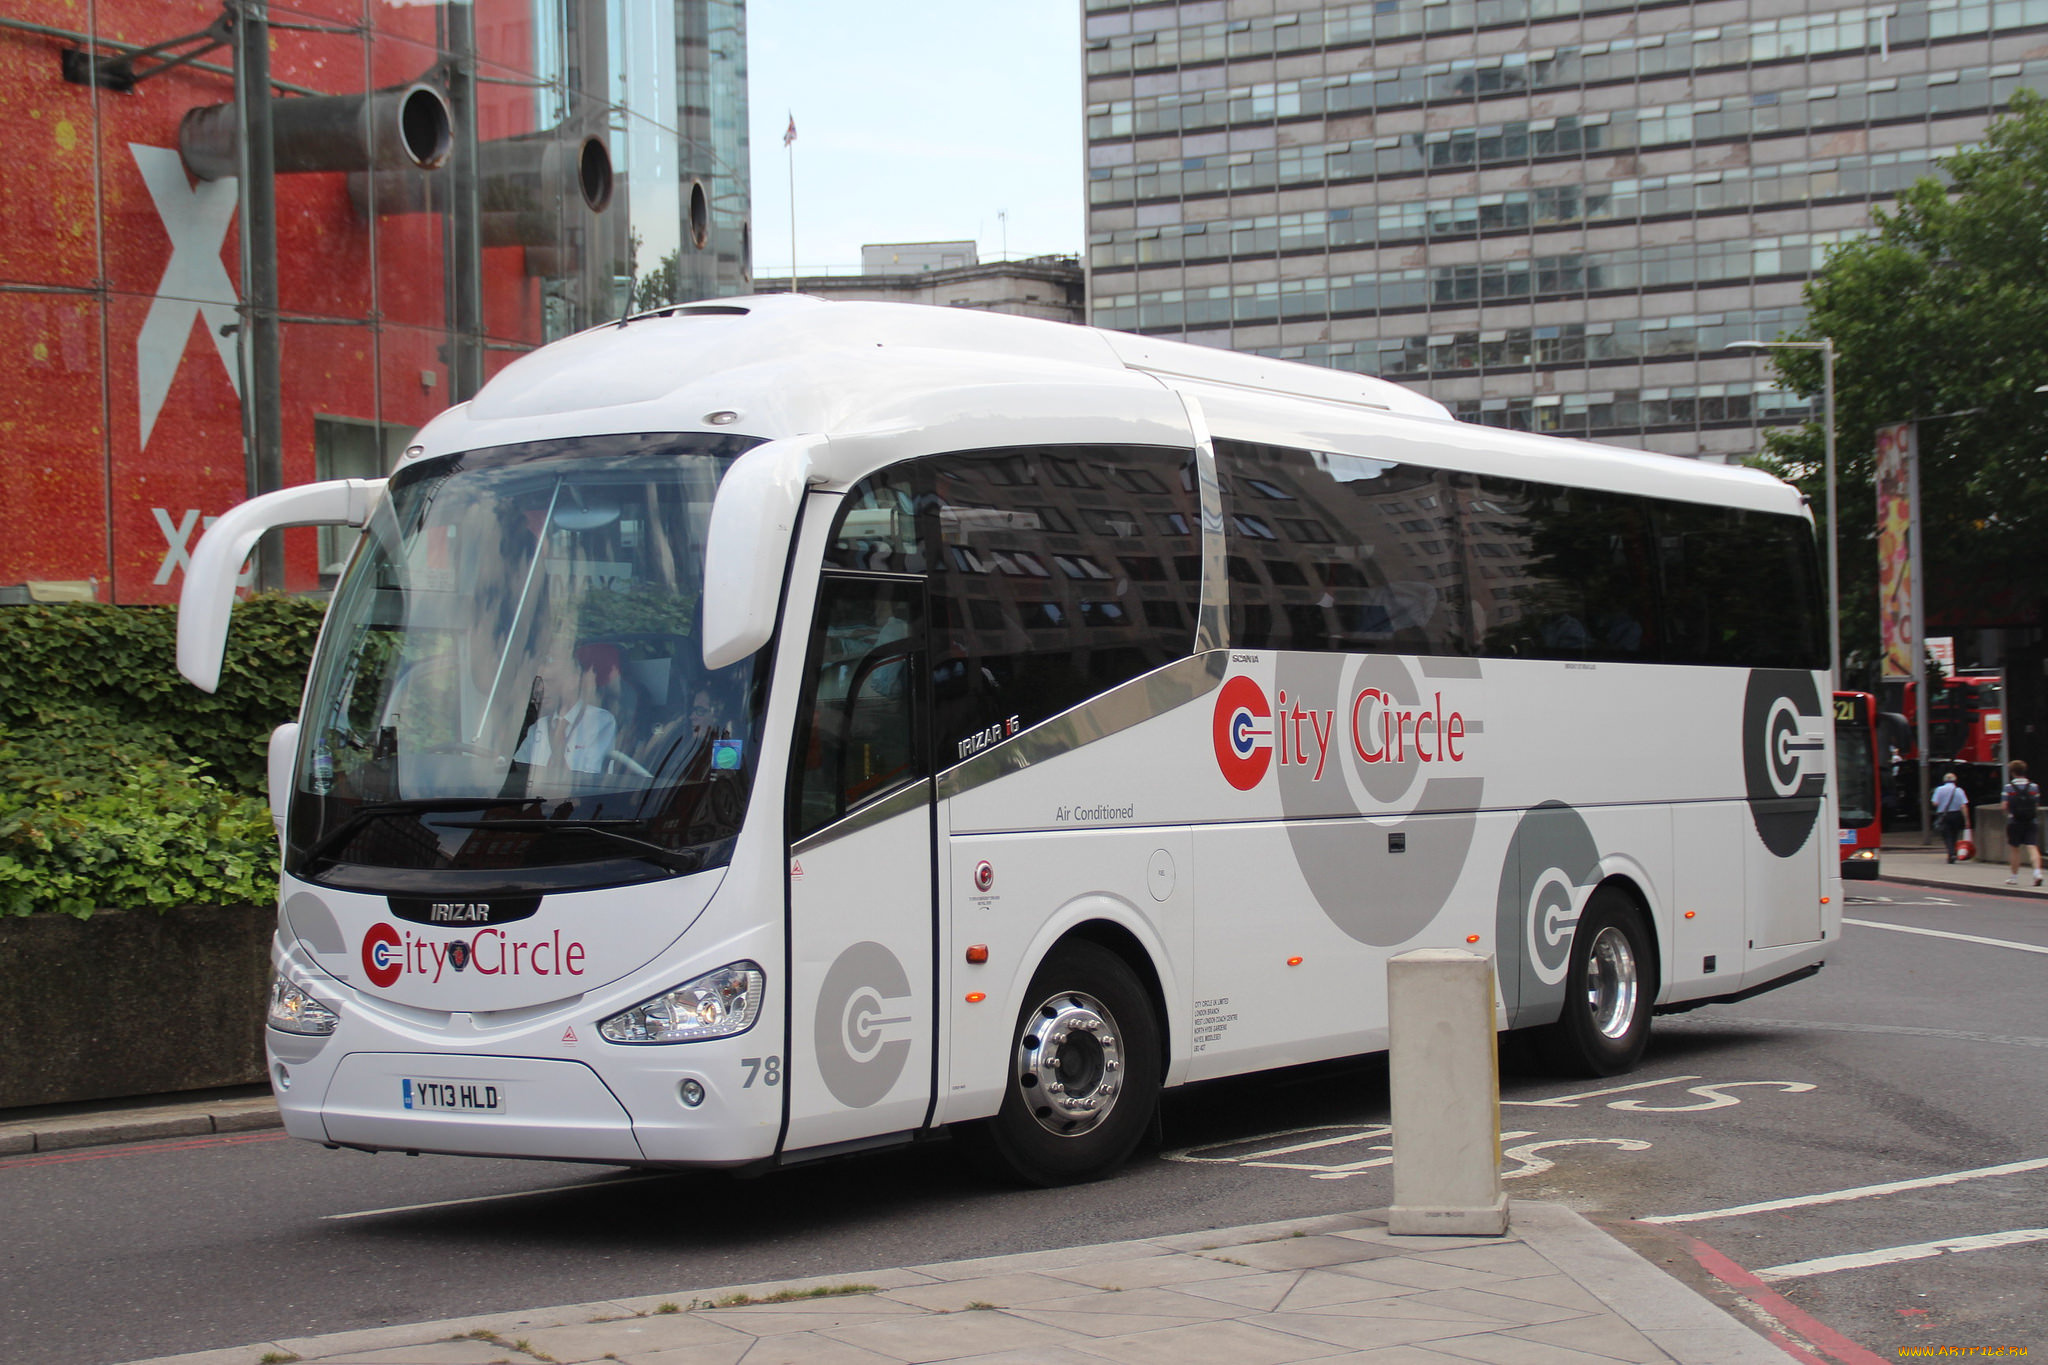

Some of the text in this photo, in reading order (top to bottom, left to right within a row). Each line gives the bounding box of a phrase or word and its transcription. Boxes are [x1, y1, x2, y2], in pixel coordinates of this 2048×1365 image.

[1232, 654, 1259, 663] SCANIA
[958, 723, 1002, 760] IRIZAR
[1212, 675, 1465, 791] City Circle
[1056, 803, 1134, 821] Air Conditioned
[430, 903, 490, 922] IRIZAR
[361, 922, 585, 988] City Circle
[741, 1055, 780, 1089] 78
[417, 1083, 498, 1109] YT13 HLD
